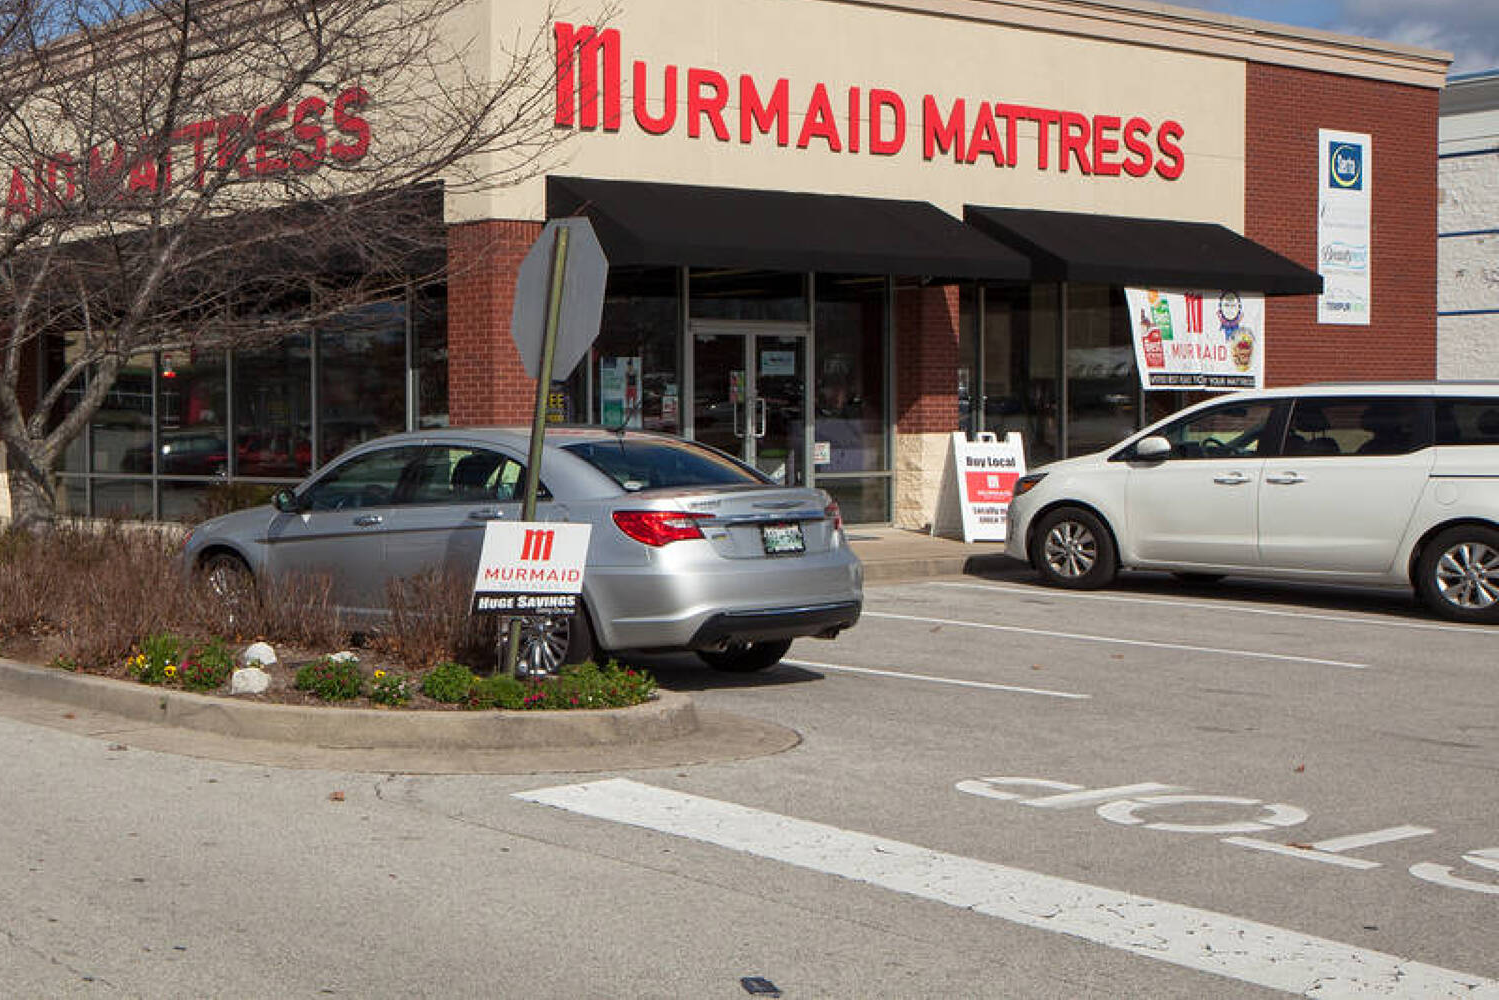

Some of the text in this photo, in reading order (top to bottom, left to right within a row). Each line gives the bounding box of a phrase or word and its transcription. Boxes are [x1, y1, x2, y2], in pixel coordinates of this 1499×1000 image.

[553, 20, 1186, 181] MURMAID MATTRESS
[484, 567, 580, 583] MURMAID
